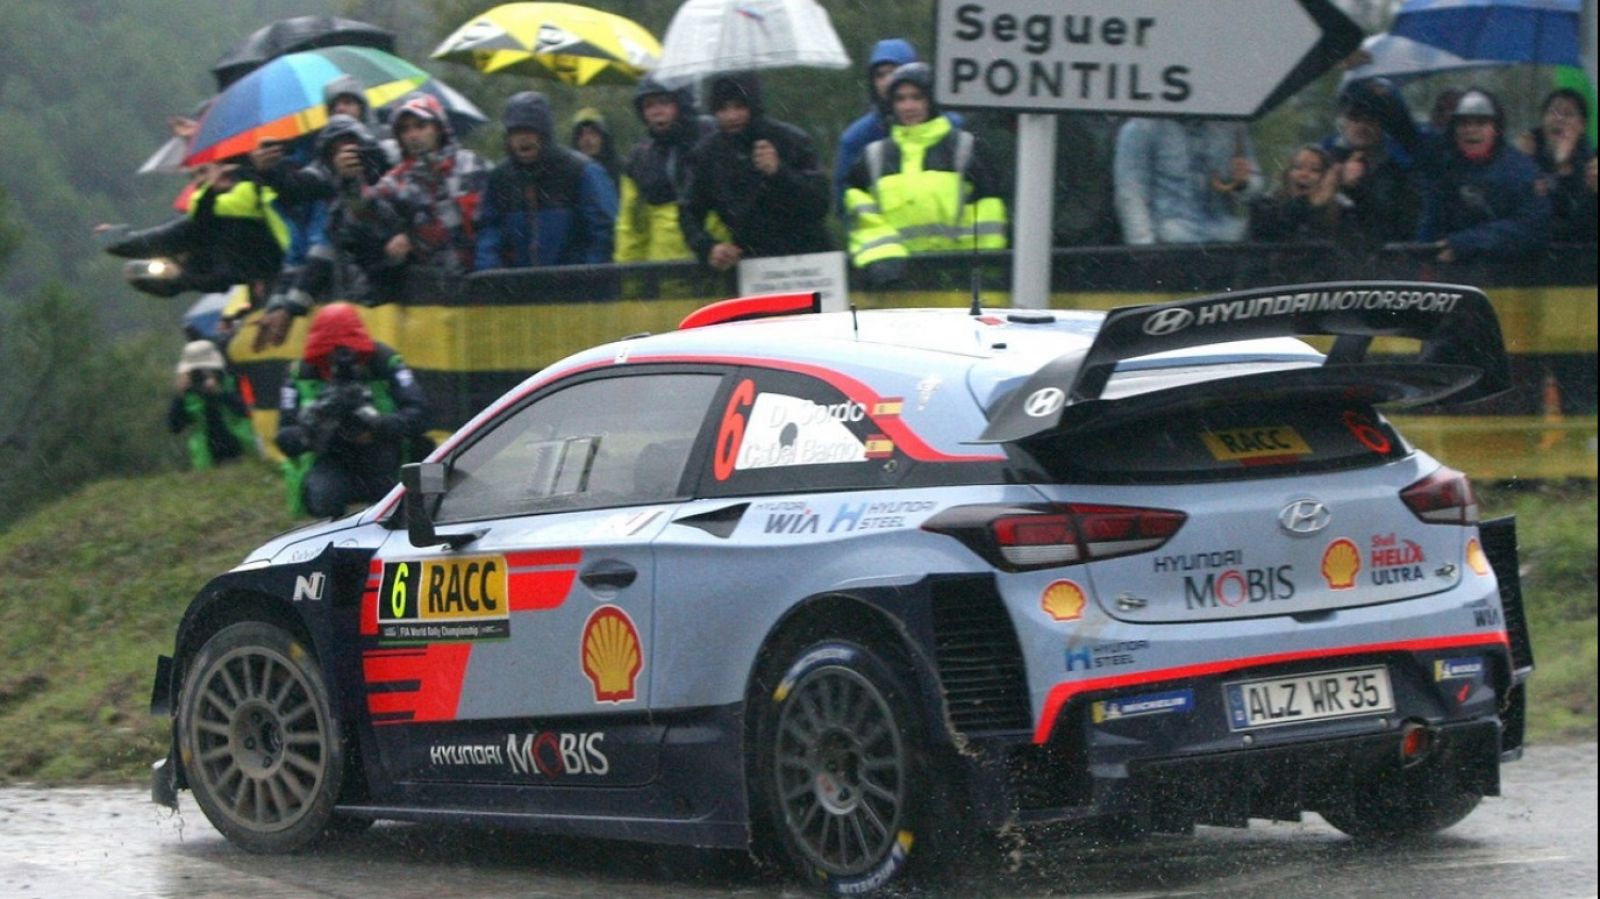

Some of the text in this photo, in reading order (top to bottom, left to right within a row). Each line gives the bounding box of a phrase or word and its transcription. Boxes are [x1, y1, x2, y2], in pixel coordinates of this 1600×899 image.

[955, 4, 1154, 54] Seguer
[952, 58, 1190, 102] PONTILS
[713, 378, 757, 481] 6
[1218, 428, 1293, 453] RACC
[1343, 410, 1393, 455] 6
[763, 513, 821, 534] WIA
[858, 515, 905, 530] STEEL
[1154, 549, 1243, 572] HYUNDAI
[1371, 540, 1424, 567] HELIX
[1371, 566, 1425, 586] ULTRA
[391, 562, 409, 619] 6
[429, 560, 497, 613] RACC
[1184, 564, 1296, 609] MOBIS
[1249, 673, 1380, 720] ALZ WR 35
[430, 730, 609, 779] HYUNDAI MOBIS
